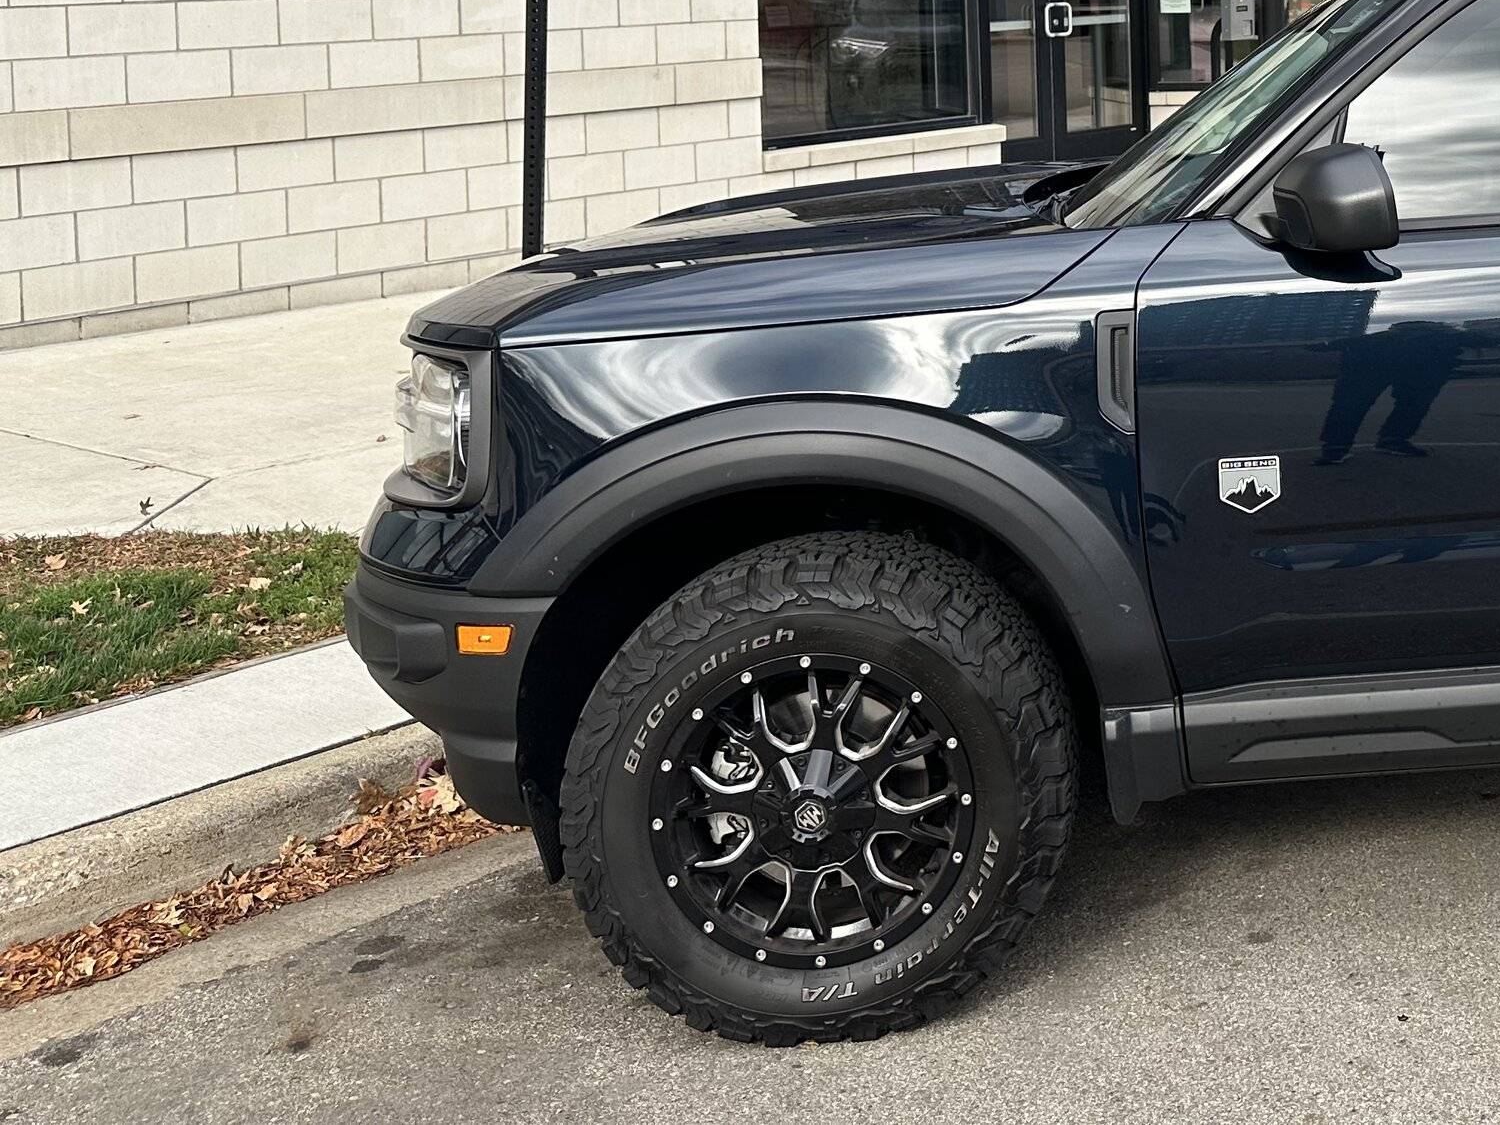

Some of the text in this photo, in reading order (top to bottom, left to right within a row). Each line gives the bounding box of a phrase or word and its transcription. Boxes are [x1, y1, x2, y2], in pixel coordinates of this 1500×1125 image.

[1244, 459, 1276, 467] BEND
[623, 628, 795, 774] BFGoodrich
[801, 828, 1000, 1002] All-Terrain T/A
